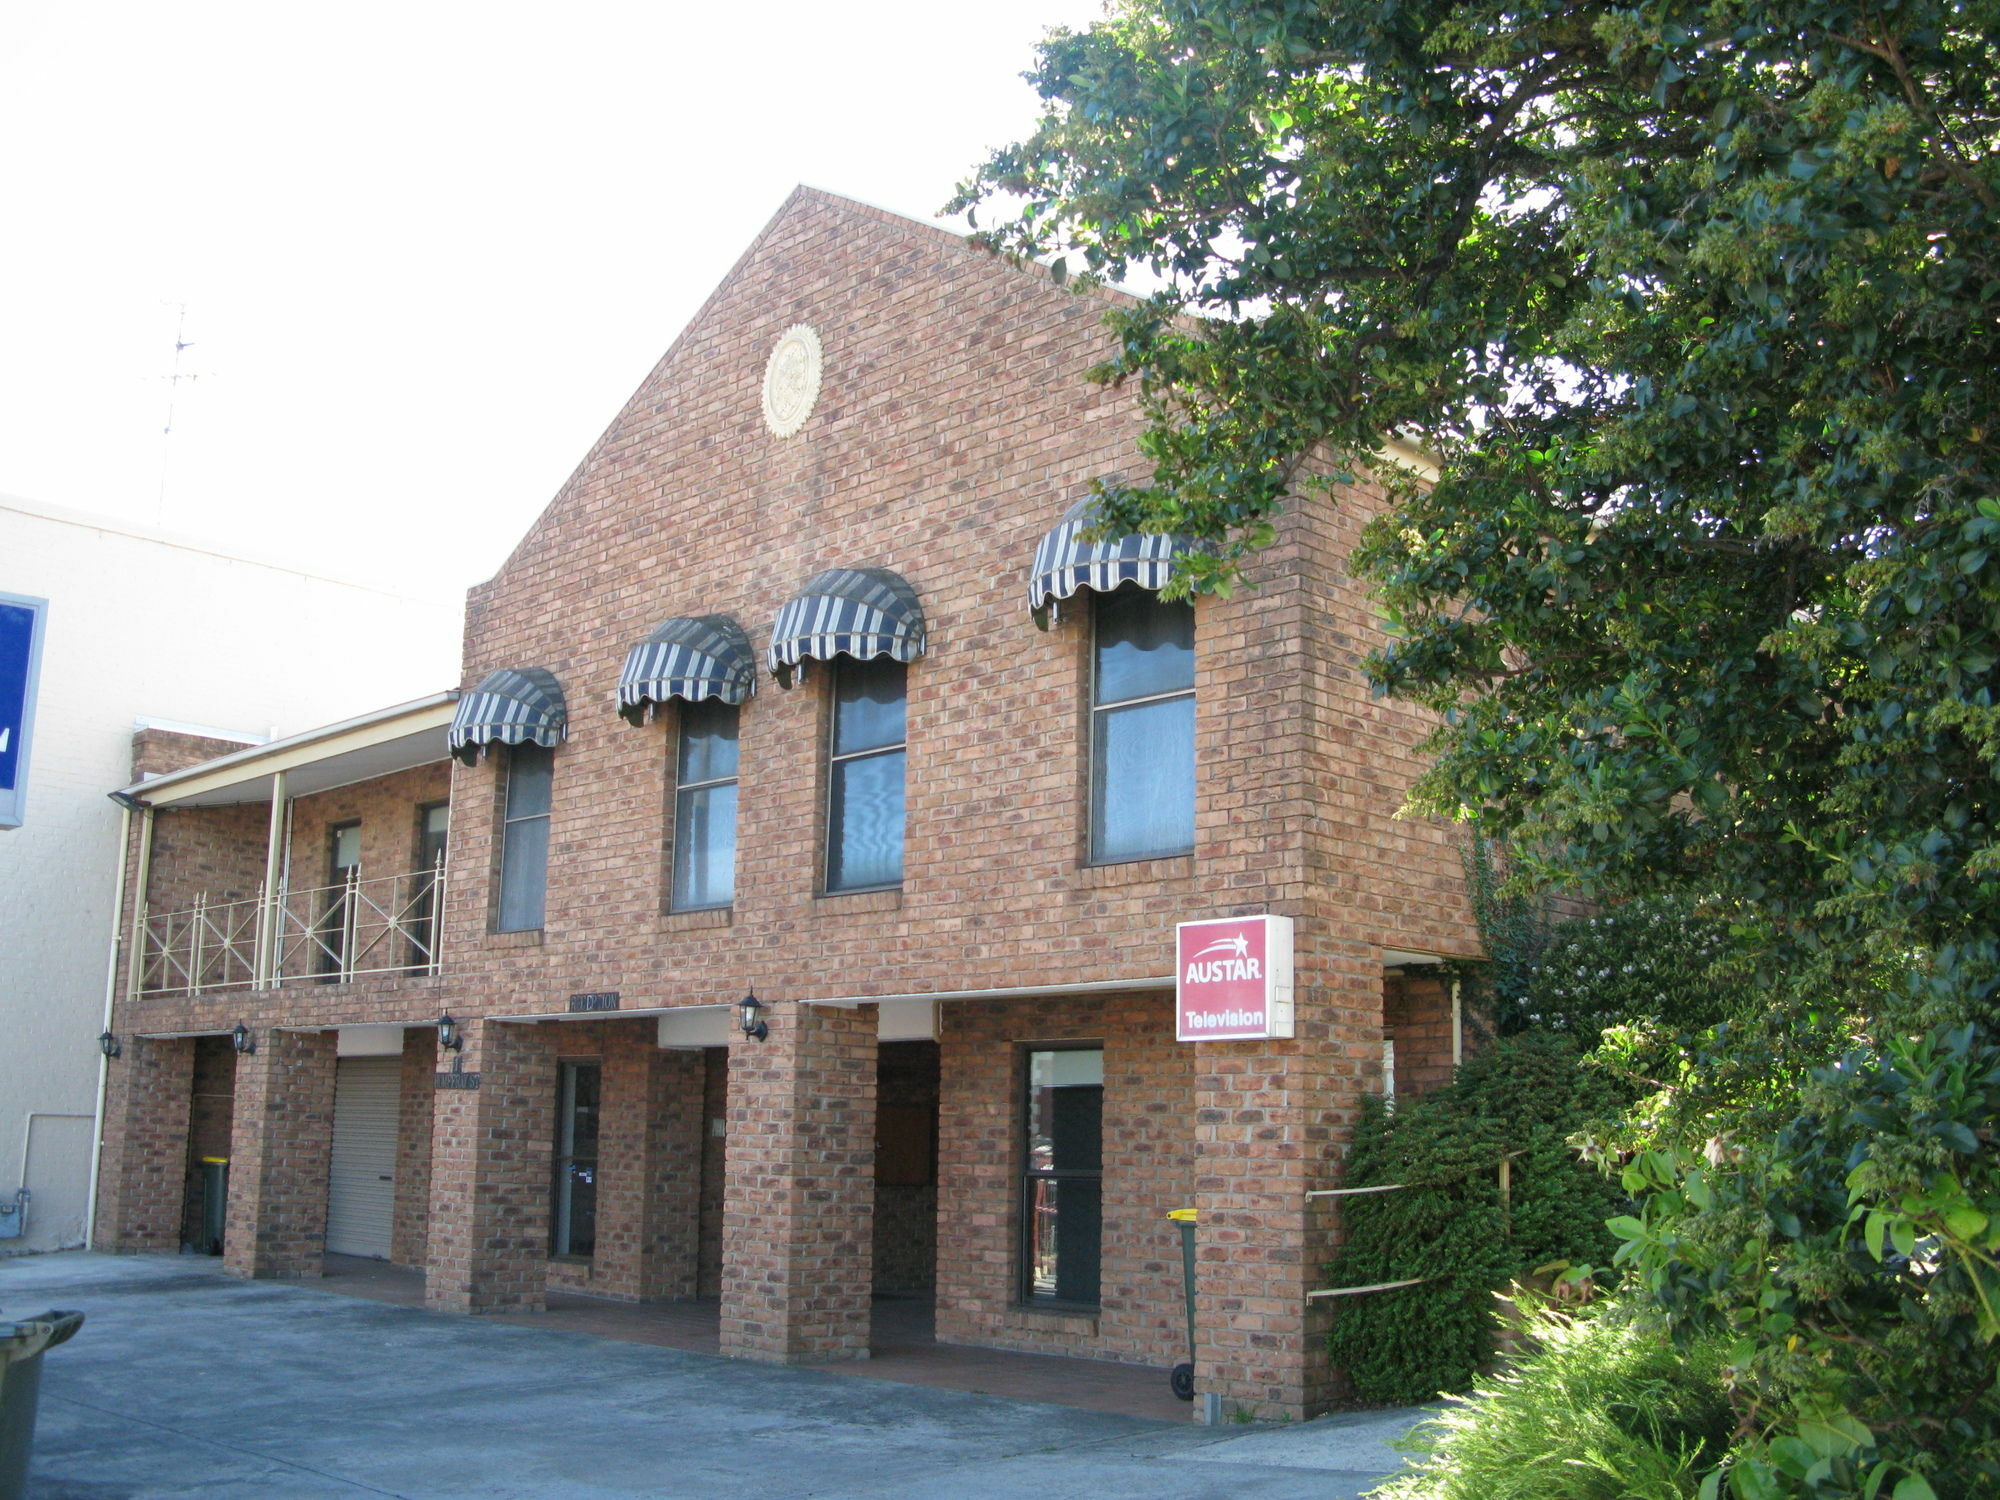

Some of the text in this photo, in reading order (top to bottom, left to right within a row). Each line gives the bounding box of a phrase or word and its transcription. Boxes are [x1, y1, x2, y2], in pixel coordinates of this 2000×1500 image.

[1185, 958, 1262, 984] AUSTAR
[570, 993, 617, 1012] RECEPION
[1185, 1008, 1264, 1029] Television
